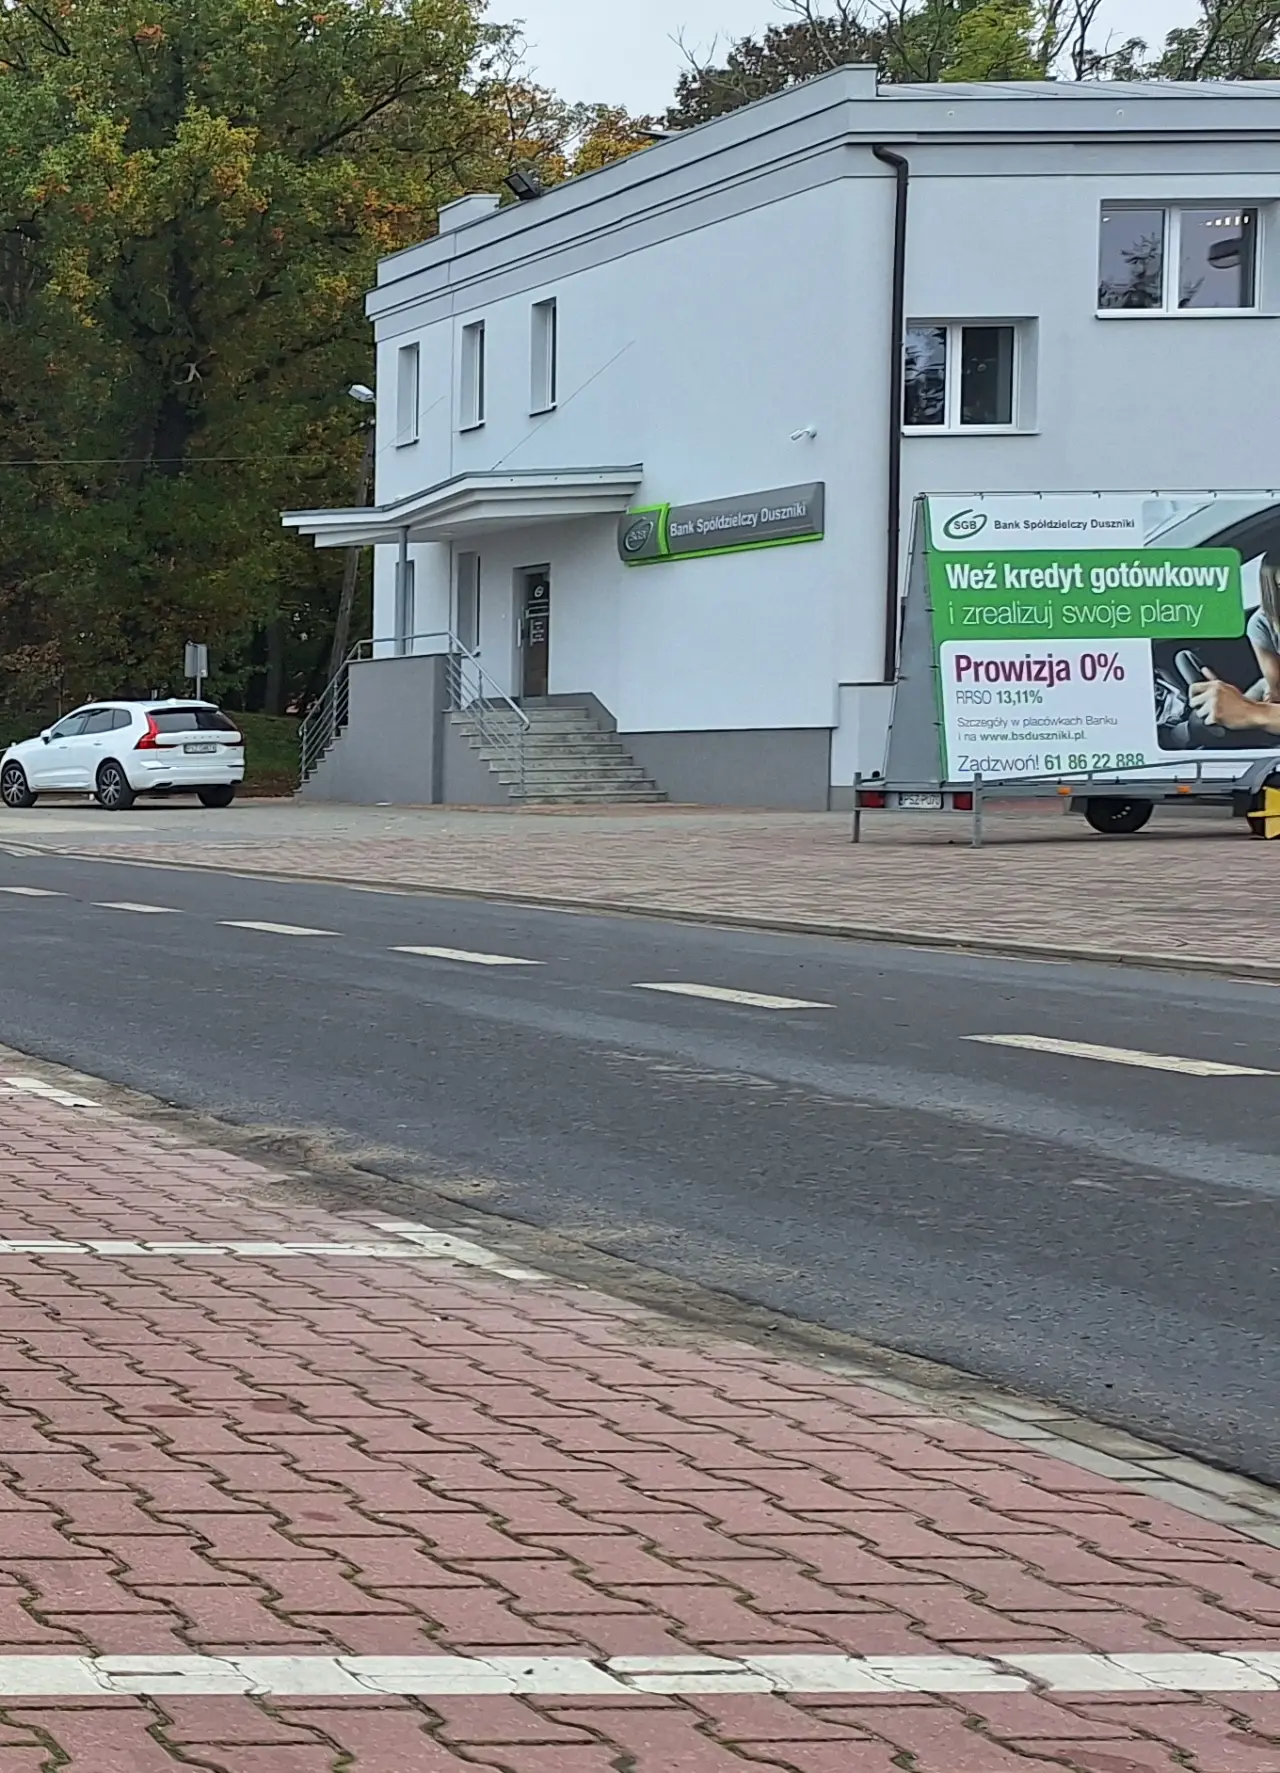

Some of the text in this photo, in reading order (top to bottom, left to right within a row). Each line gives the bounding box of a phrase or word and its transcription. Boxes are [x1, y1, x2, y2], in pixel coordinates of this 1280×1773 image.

[670, 501, 806, 537] Bank Spółdzielczy Duszniki
[953, 520, 977, 530] SGB
[994, 519, 1135, 531] Bank Spółdzielczy Duszniki
[945, 561, 1230, 594] Weź kredyt gotówkowy
[949, 599, 1204, 629] i zrealizuj swoje plany
[955, 652, 1125, 688] Prowizja 0%
[956, 689, 1043, 706] RRSO 13,11%
[957, 716, 1008, 729] Szczegóły
[1085, 715, 1118, 726] Banku
[958, 752, 1145, 772] Zadzwoń! 61 86 22 888
